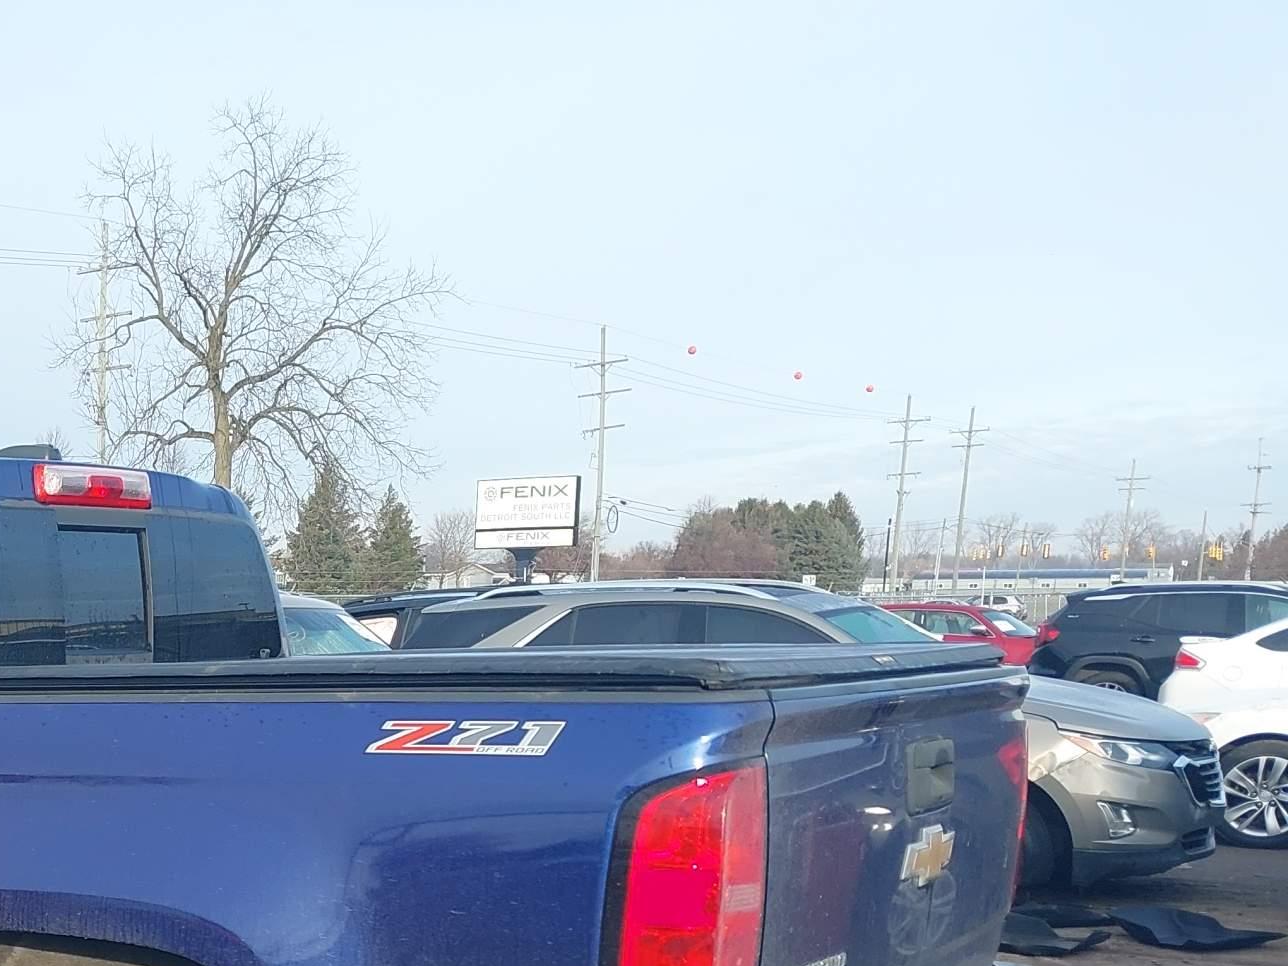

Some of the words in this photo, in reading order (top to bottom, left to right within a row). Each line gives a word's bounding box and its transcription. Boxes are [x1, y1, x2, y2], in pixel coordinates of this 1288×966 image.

[500, 484, 569, 498] FENIX
[513, 504, 539, 512] FENIX
[541, 502, 571, 511] PARTS
[506, 532, 550, 541] FENIX
[365, 720, 566, 755] Z71
[508, 746, 545, 754] ROAD
